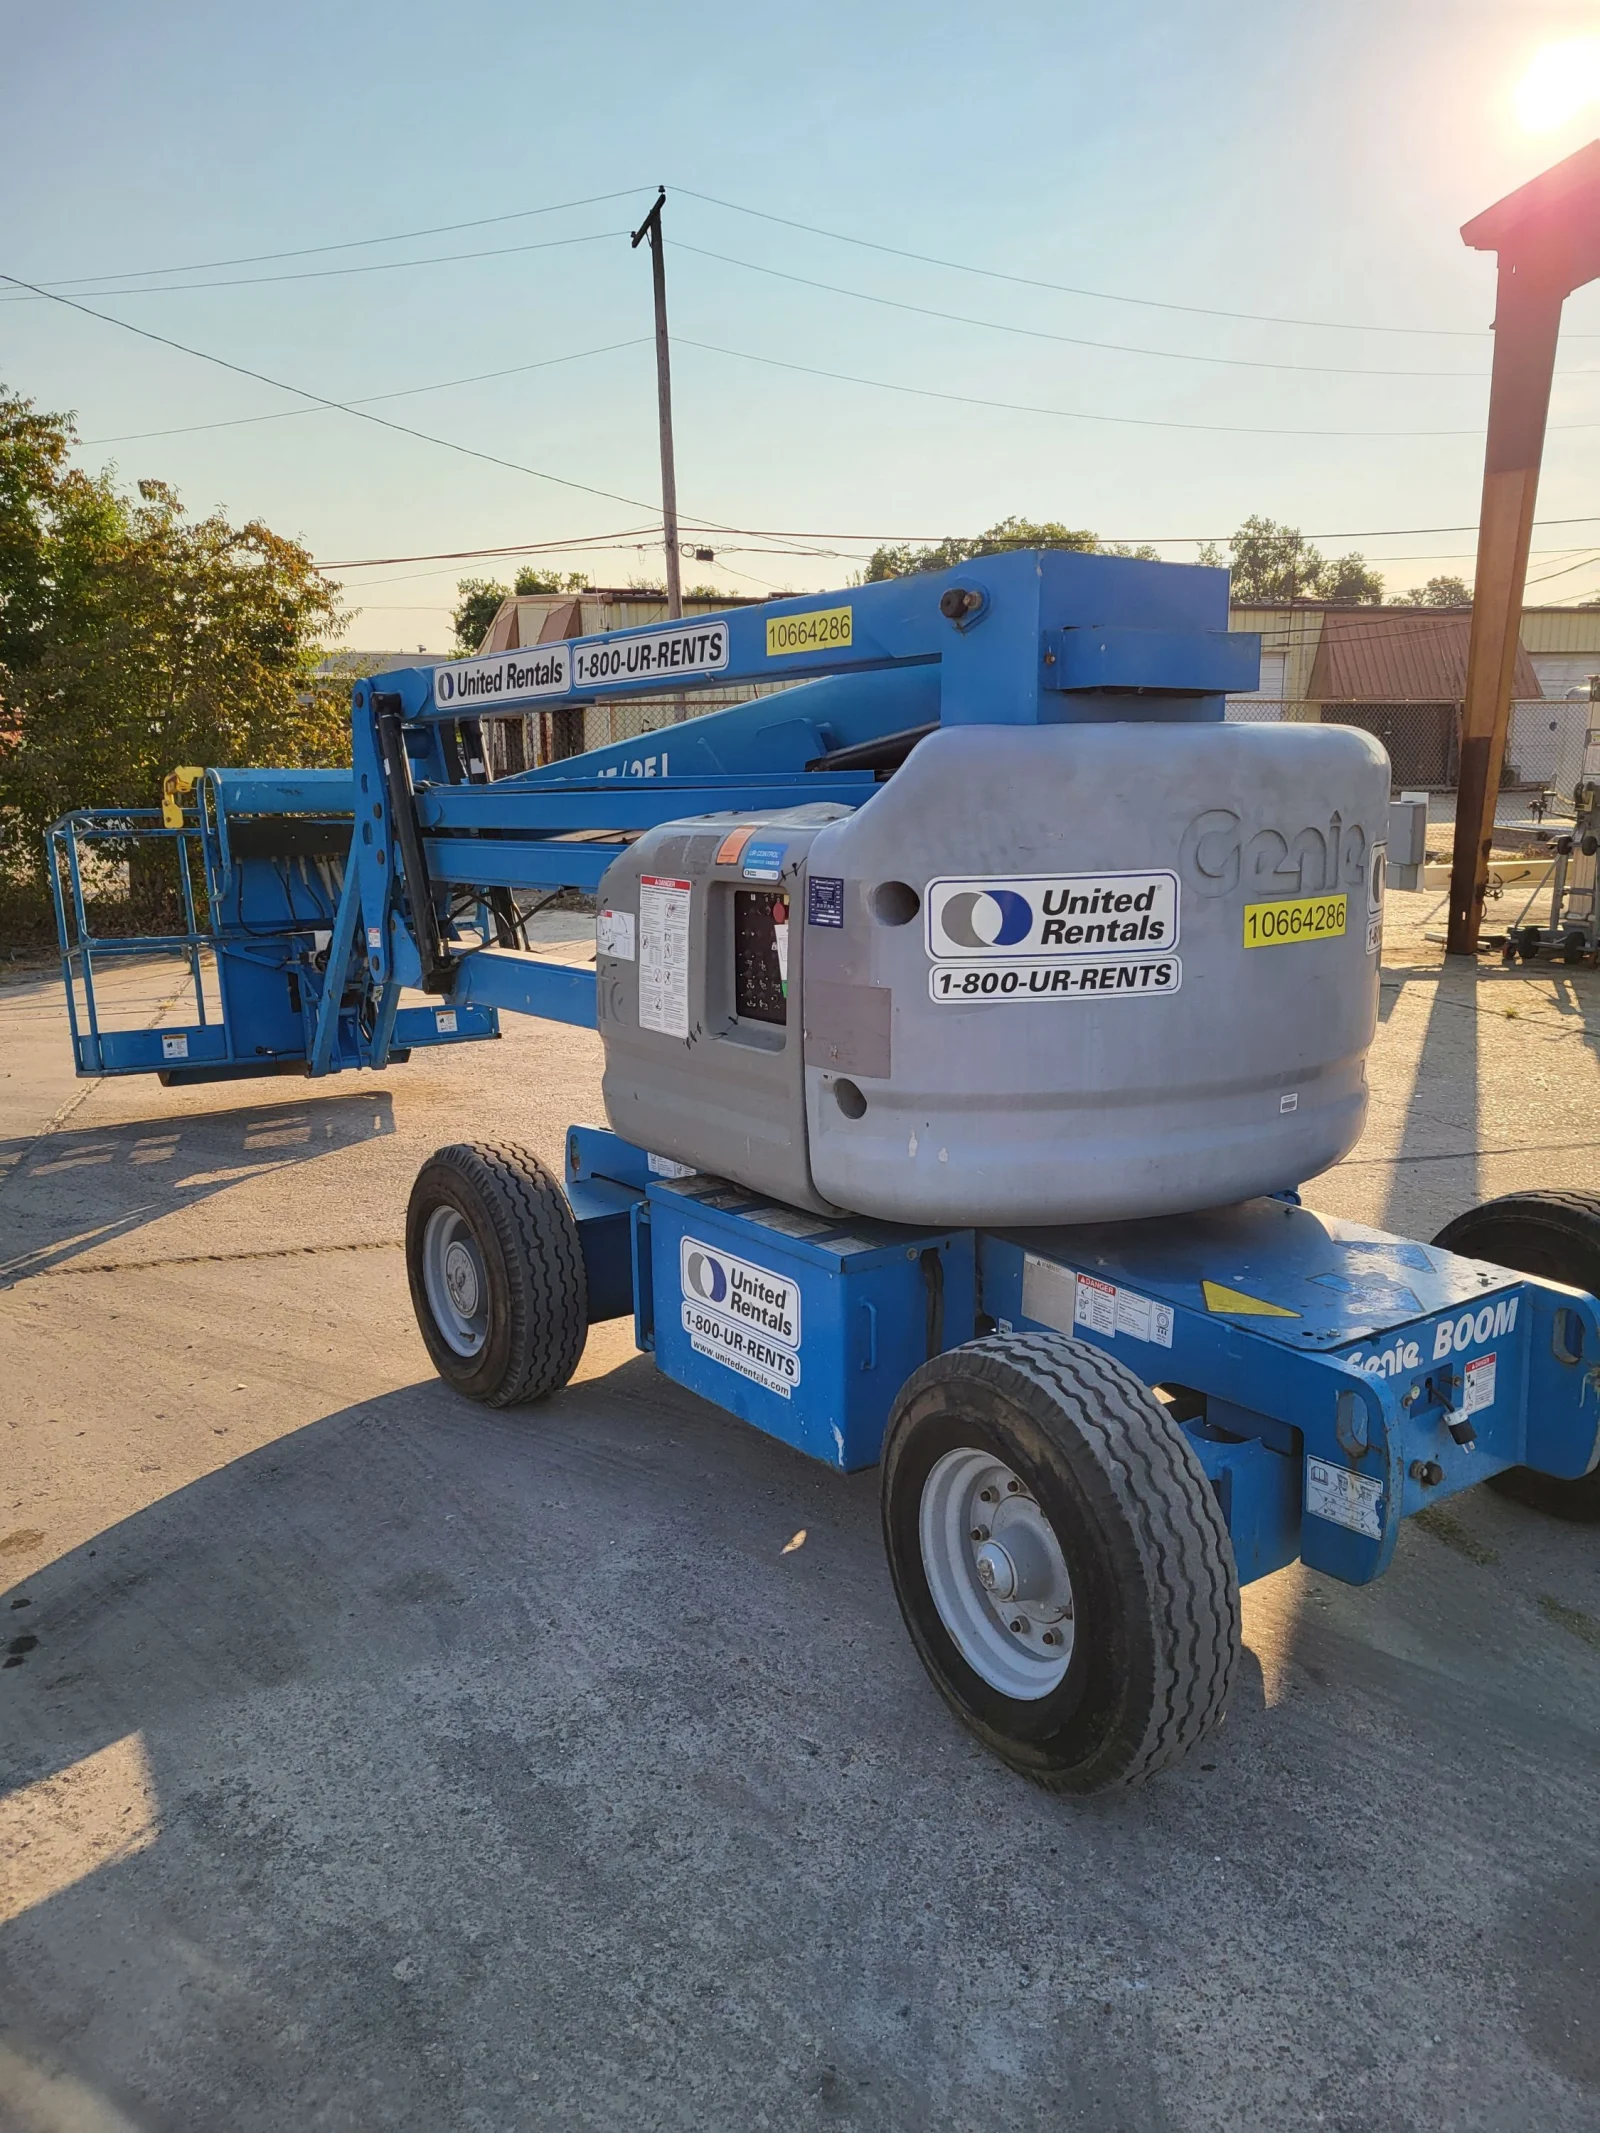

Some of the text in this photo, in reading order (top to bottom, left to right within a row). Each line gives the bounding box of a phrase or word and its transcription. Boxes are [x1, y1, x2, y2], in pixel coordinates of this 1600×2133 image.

[769, 614, 851, 648] 10664286
[457, 655, 564, 697] United Rentals
[577, 632, 723, 680] 1-800-UR-RENTS
[1179, 809, 1366, 899] Genie
[1041, 885, 1157, 916] United
[1248, 902, 1346, 939] 10664286
[1040, 915, 1166, 945] Rentals
[939, 963, 1173, 995] 1-800-UR-RENTS
[731, 1267, 788, 1310] United
[1085, 1279, 1115, 1295] DANGER
[730, 1291, 793, 1337] Rentals
[1433, 1297, 1520, 1361] BOOM
[685, 1310, 796, 1377] 1-800-UR-RENTS
[693, 1340, 790, 1397] www.unitedrentals.com
